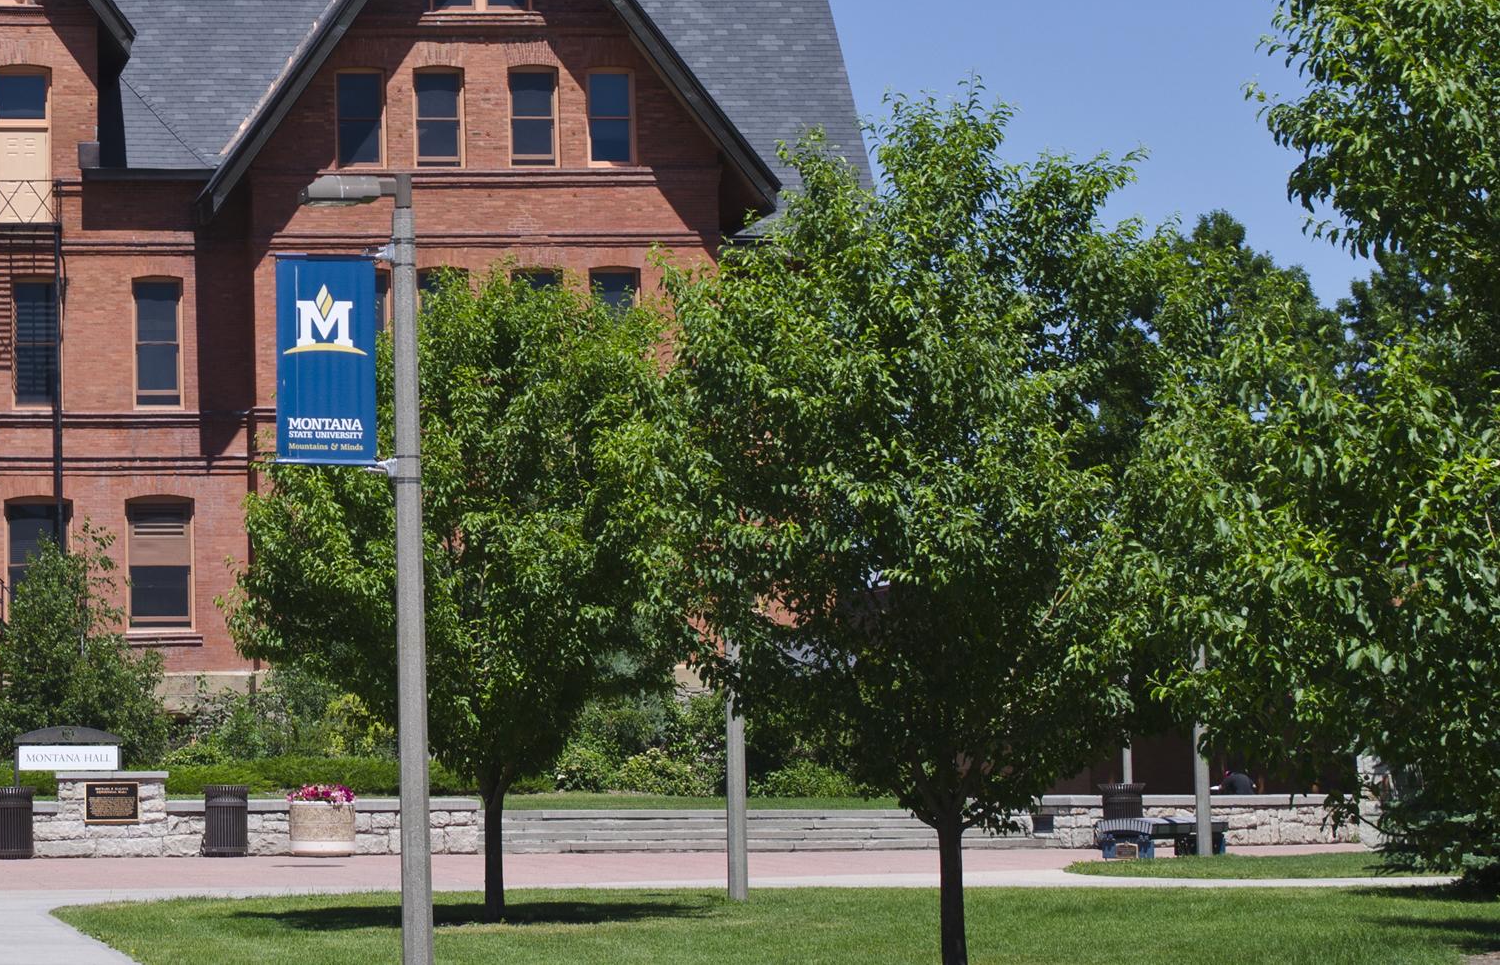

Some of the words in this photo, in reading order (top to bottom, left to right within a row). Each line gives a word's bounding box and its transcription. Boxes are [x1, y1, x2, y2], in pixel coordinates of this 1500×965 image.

[296, 299, 354, 348] M
[287, 417, 363, 431] MONTANA
[288, 430, 313, 439] STATE
[315, 431, 363, 440] UNIVERSITY
[288, 442, 328, 450] Mountains
[330, 442, 338, 451] &
[340, 443, 364, 451] Minds
[26, 753, 80, 763] MONTANA
[84, 753, 112, 763] HALL
